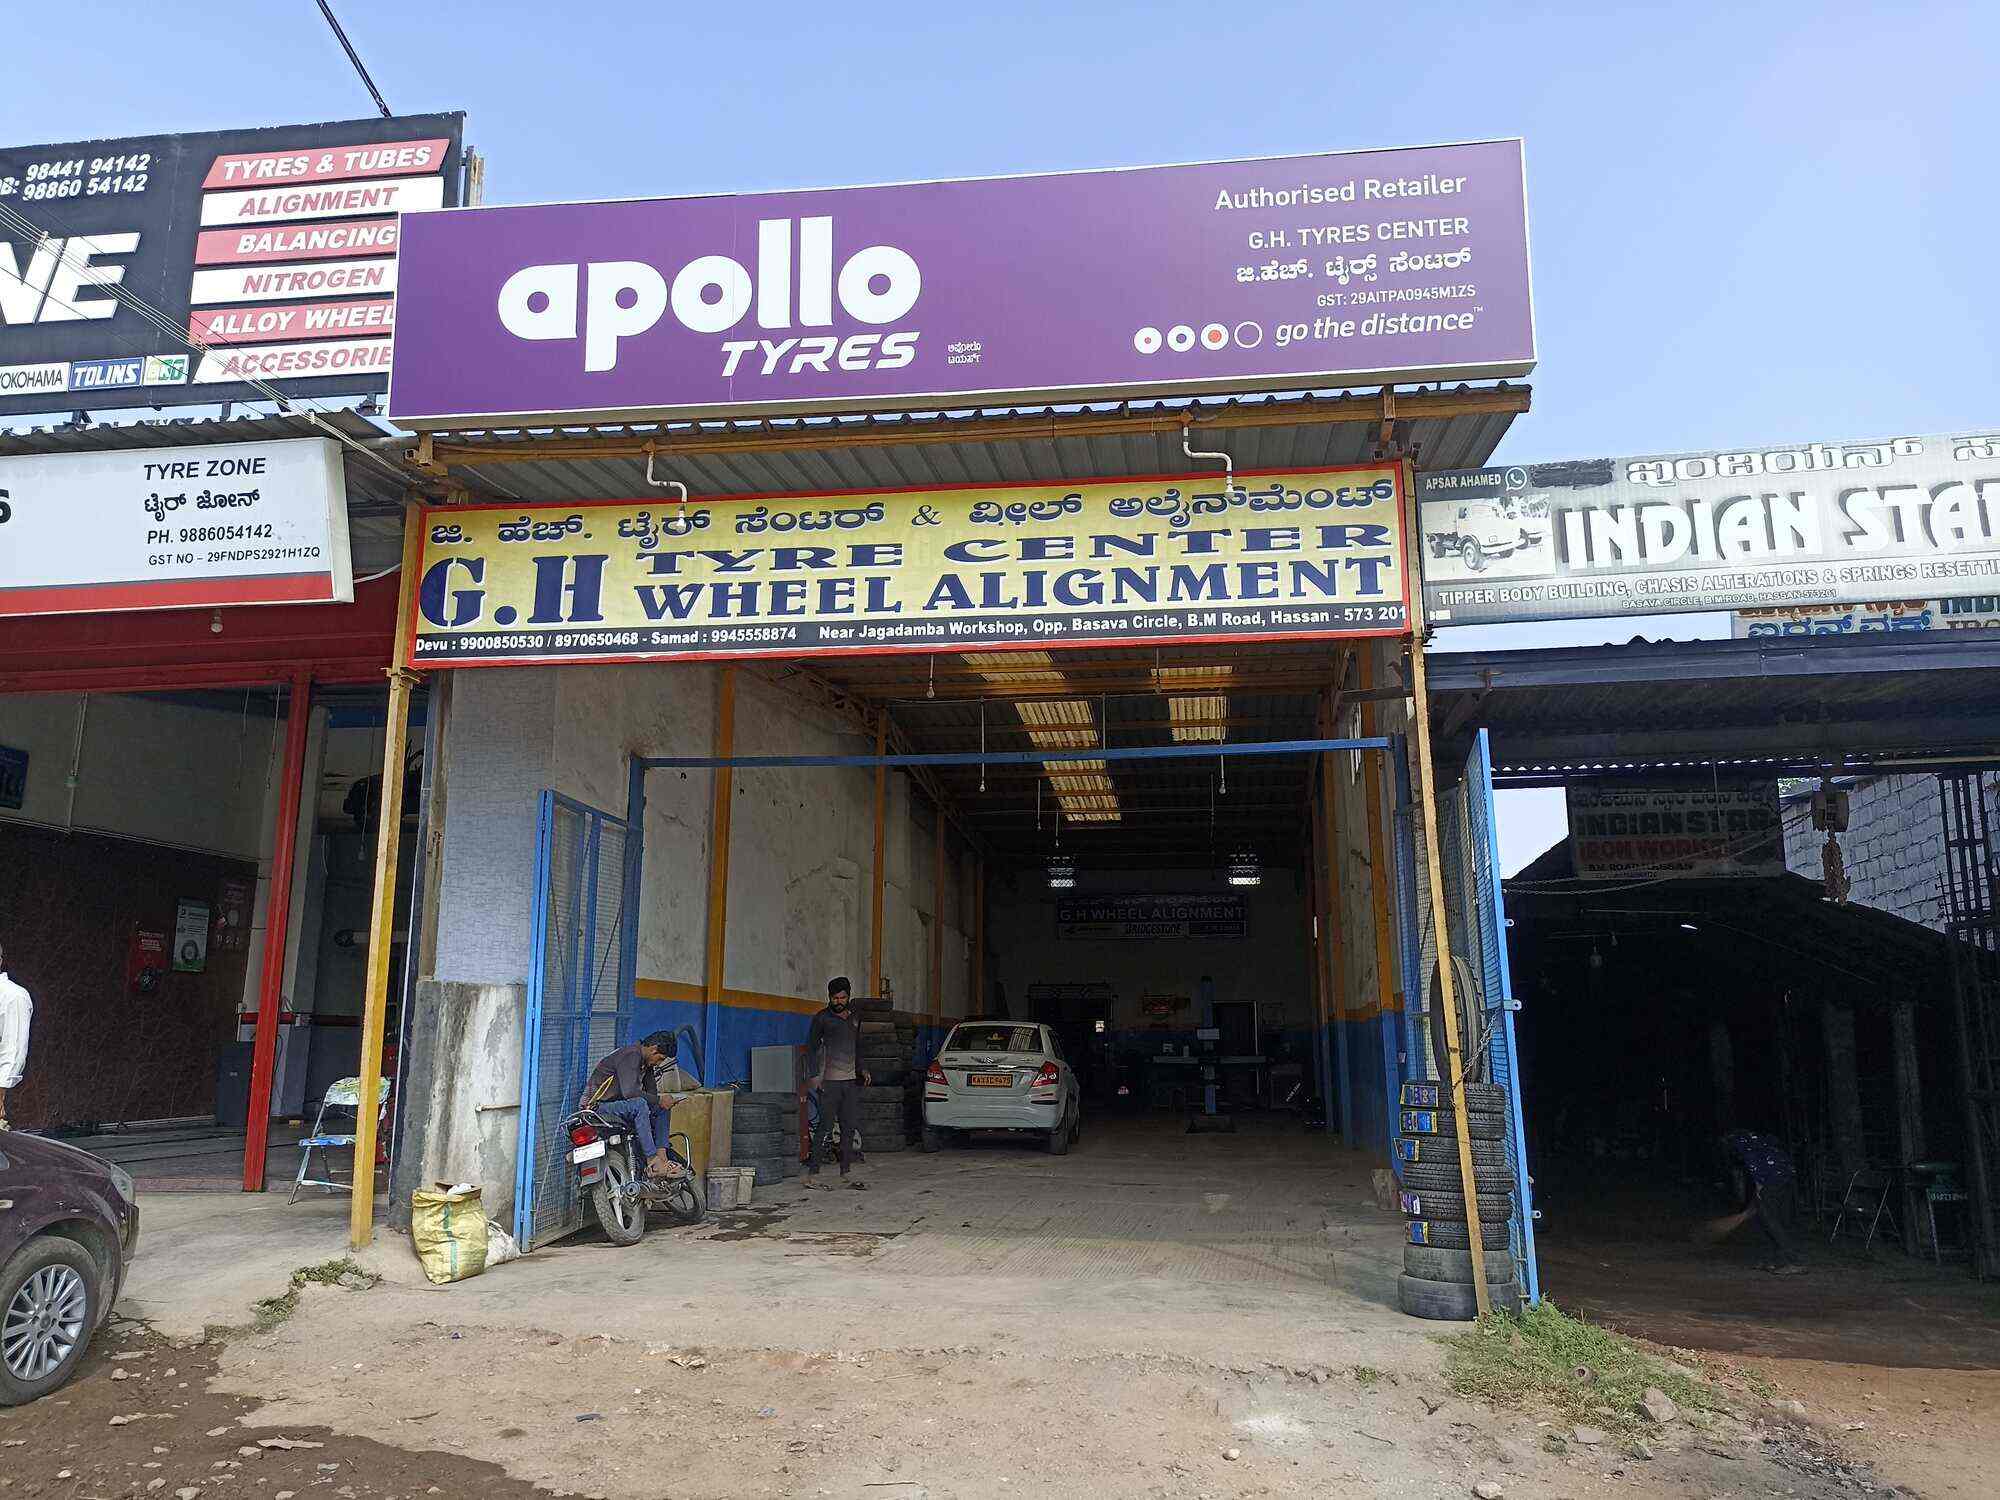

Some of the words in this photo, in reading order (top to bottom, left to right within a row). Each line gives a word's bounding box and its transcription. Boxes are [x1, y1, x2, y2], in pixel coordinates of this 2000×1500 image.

[26, 160, 84, 181] 98441
[89, 154, 150, 174] 94142
[223, 156, 309, 180] TYRES
[316, 154, 335, 173] &
[344, 147, 432, 171] TUBES
[23, 179, 82, 200] 98860
[86, 174, 148, 195] 54142
[239, 187, 399, 217] ALIGNMENT
[1214, 181, 1355, 210] Authorised
[1364, 175, 1467, 200] Retailer
[236, 226, 397, 253] BALANCING
[1248, 231, 1291, 249] G.H.
[1298, 224, 1370, 246] TYRES
[1377, 217, 1470, 240] CENTER
[1389, 247, 1471, 272] ಸೆಂಟರ್
[242, 267, 384, 294] NITROGEN
[498, 216, 921, 372] apollo
[1316, 293, 1347, 307] GST:
[1350, 284, 1476, 305] 29AITPA0945M1ZS
[205, 311, 296, 335] ALLOY
[1275, 323, 1309, 347] go
[1314, 317, 1355, 339] the
[1361, 311, 1475, 336] distance
[721, 331, 920, 377] TYRES
[74, 363, 140, 387] TOLINS
[143, 462, 200, 480] TYRE
[206, 457, 266, 477] ZONE
[1460, 473, 1502, 488] AHAMED
[144, 492, 187, 521] ಟೈರ್
[196, 489, 260, 510] ಜೋನ್
[147, 530, 173, 544] PH.
[180, 524, 273, 542] 9886054142
[498, 515, 593, 542] ಹೆಚ್.
[617, 510, 711, 549] ಟೈರ್
[735, 502, 885, 534] ಸೆಂಟರ್
[911, 504, 942, 526] &
[1558, 490, 1824, 571] INDIAN
[148, 554, 172, 565] GST
[176, 553, 194, 563] NO
[207, 547, 320, 563] 29FNDPS2921H1ZQ
[419, 554, 609, 628] G.H
[635, 543, 904, 575] TYRE
[943, 524, 1393, 563] CENTER
[634, 576, 902, 620] WHEEL
[922, 556, 1393, 611] ALIGNMENT
[1438, 588, 1496, 605] TIPPER
[1500, 585, 1545, 602] BODY
[1549, 580, 1631, 600] BUILDING,
[1635, 577, 1699, 594] CHASIS
[1701, 569, 1819, 591] ALTERATIONS
[1823, 570, 1837, 585] &
[1839, 563, 1918, 582] SPRINGS
[1920, 559, 2000, 578] RESETTI
[416, 638, 448, 651] Devu
[460, 634, 543, 650] 9900850530
[555, 632, 639, 647] 8970650468
[651, 630, 699, 645] Samad
[711, 627, 797, 642] 9945558874
[819, 625, 857, 639] Near
[858, 621, 945, 640] Jagadamba
[949, 619, 1028, 638] Workshop,
[1032, 618, 1067, 635] Opp.
[1071, 616, 1128, 631] Basava
[1132, 614, 1182, 630] Circle,
[1187, 613, 1217, 627] B.M
[1222, 611, 1266, 626] Road,
[1271, 609, 1330, 624] Hassan
[1344, 607, 1374, 622] 573
[1378, 605, 1407, 620] 201
[1090, 906, 1148, 921] WHEEL
[1150, 905, 1245, 920] ALIGNMENT
